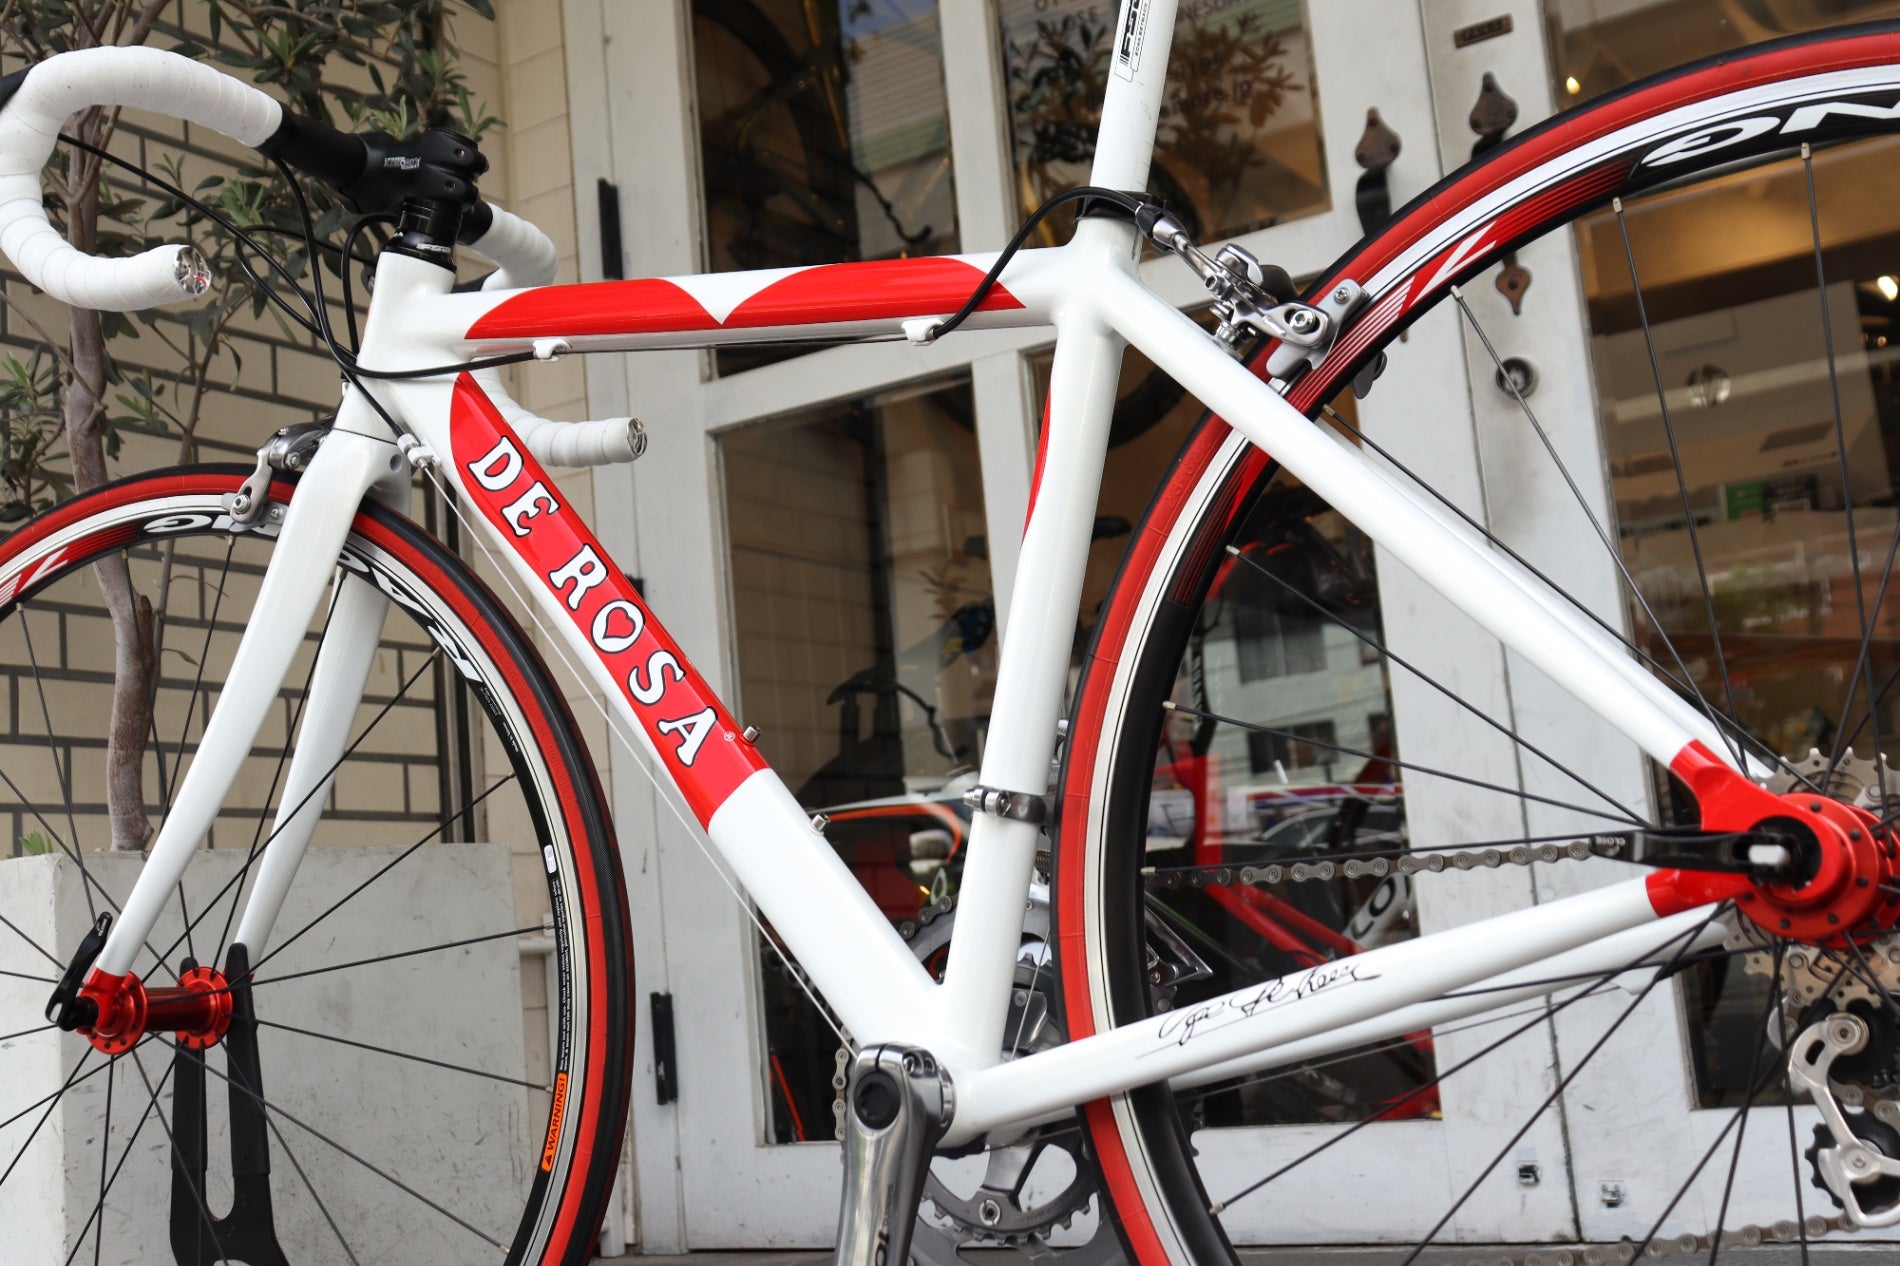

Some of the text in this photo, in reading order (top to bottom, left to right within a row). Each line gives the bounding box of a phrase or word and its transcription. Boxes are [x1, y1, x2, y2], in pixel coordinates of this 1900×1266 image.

[467, 435, 560, 538] DE
[549, 543, 719, 768] ROSA
[547, 1077, 566, 1151] WARNING!
